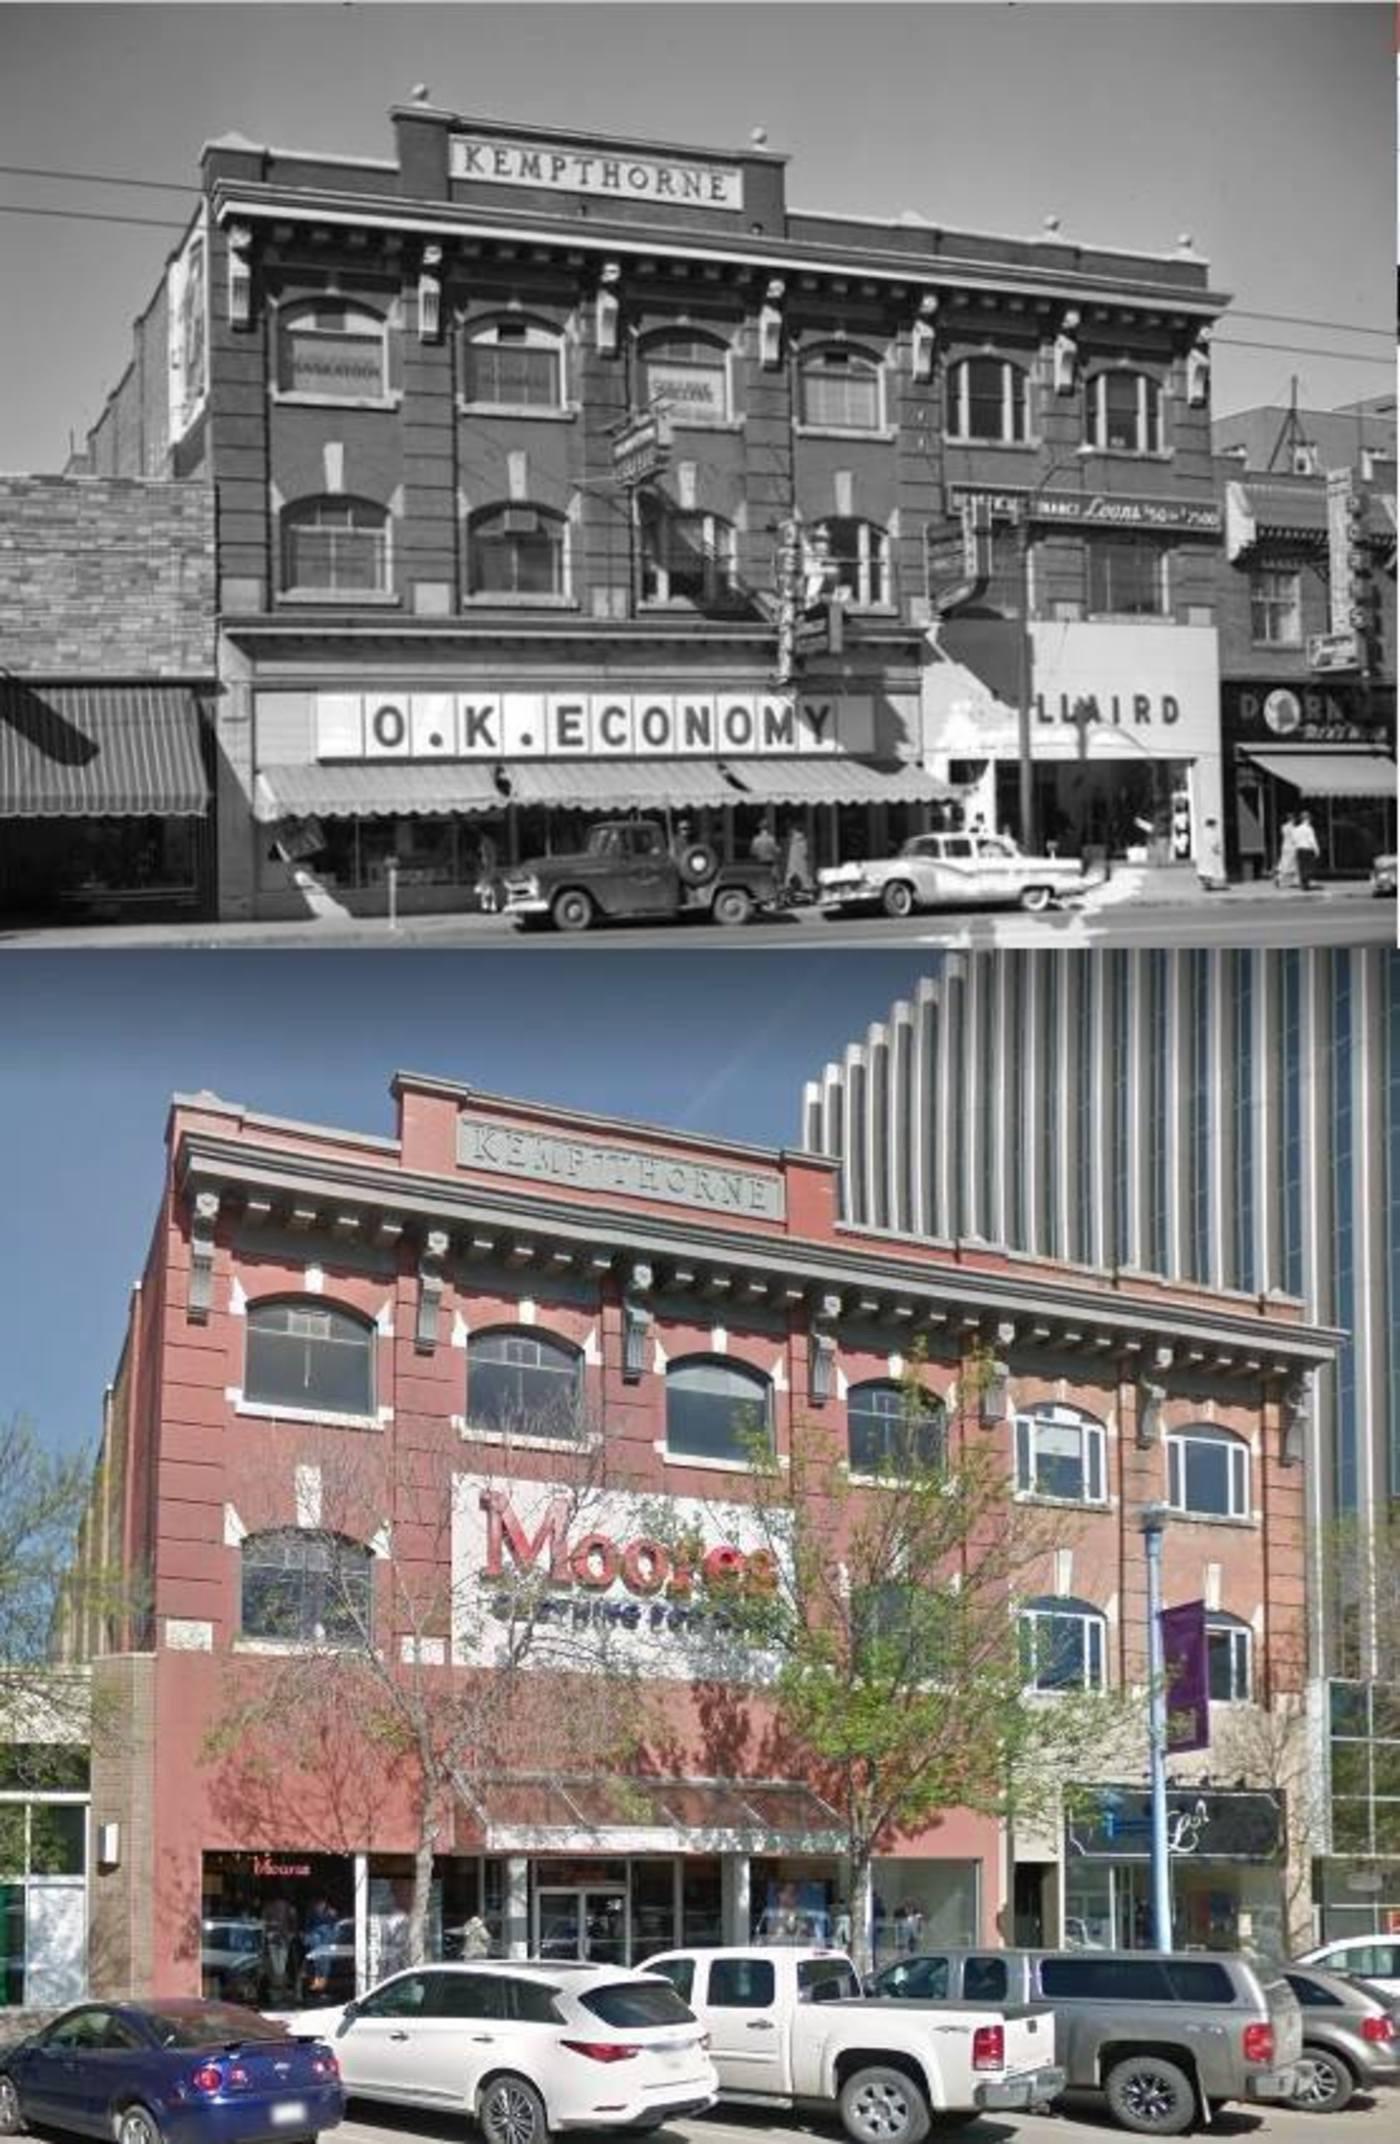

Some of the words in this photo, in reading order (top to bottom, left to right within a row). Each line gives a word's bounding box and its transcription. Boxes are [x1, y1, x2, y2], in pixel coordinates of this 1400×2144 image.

[464, 145, 728, 202] KEMPTHORNE
[556, 704, 832, 748] ECONOMY
[472, 1123, 769, 1212] KEMPTHORNE
